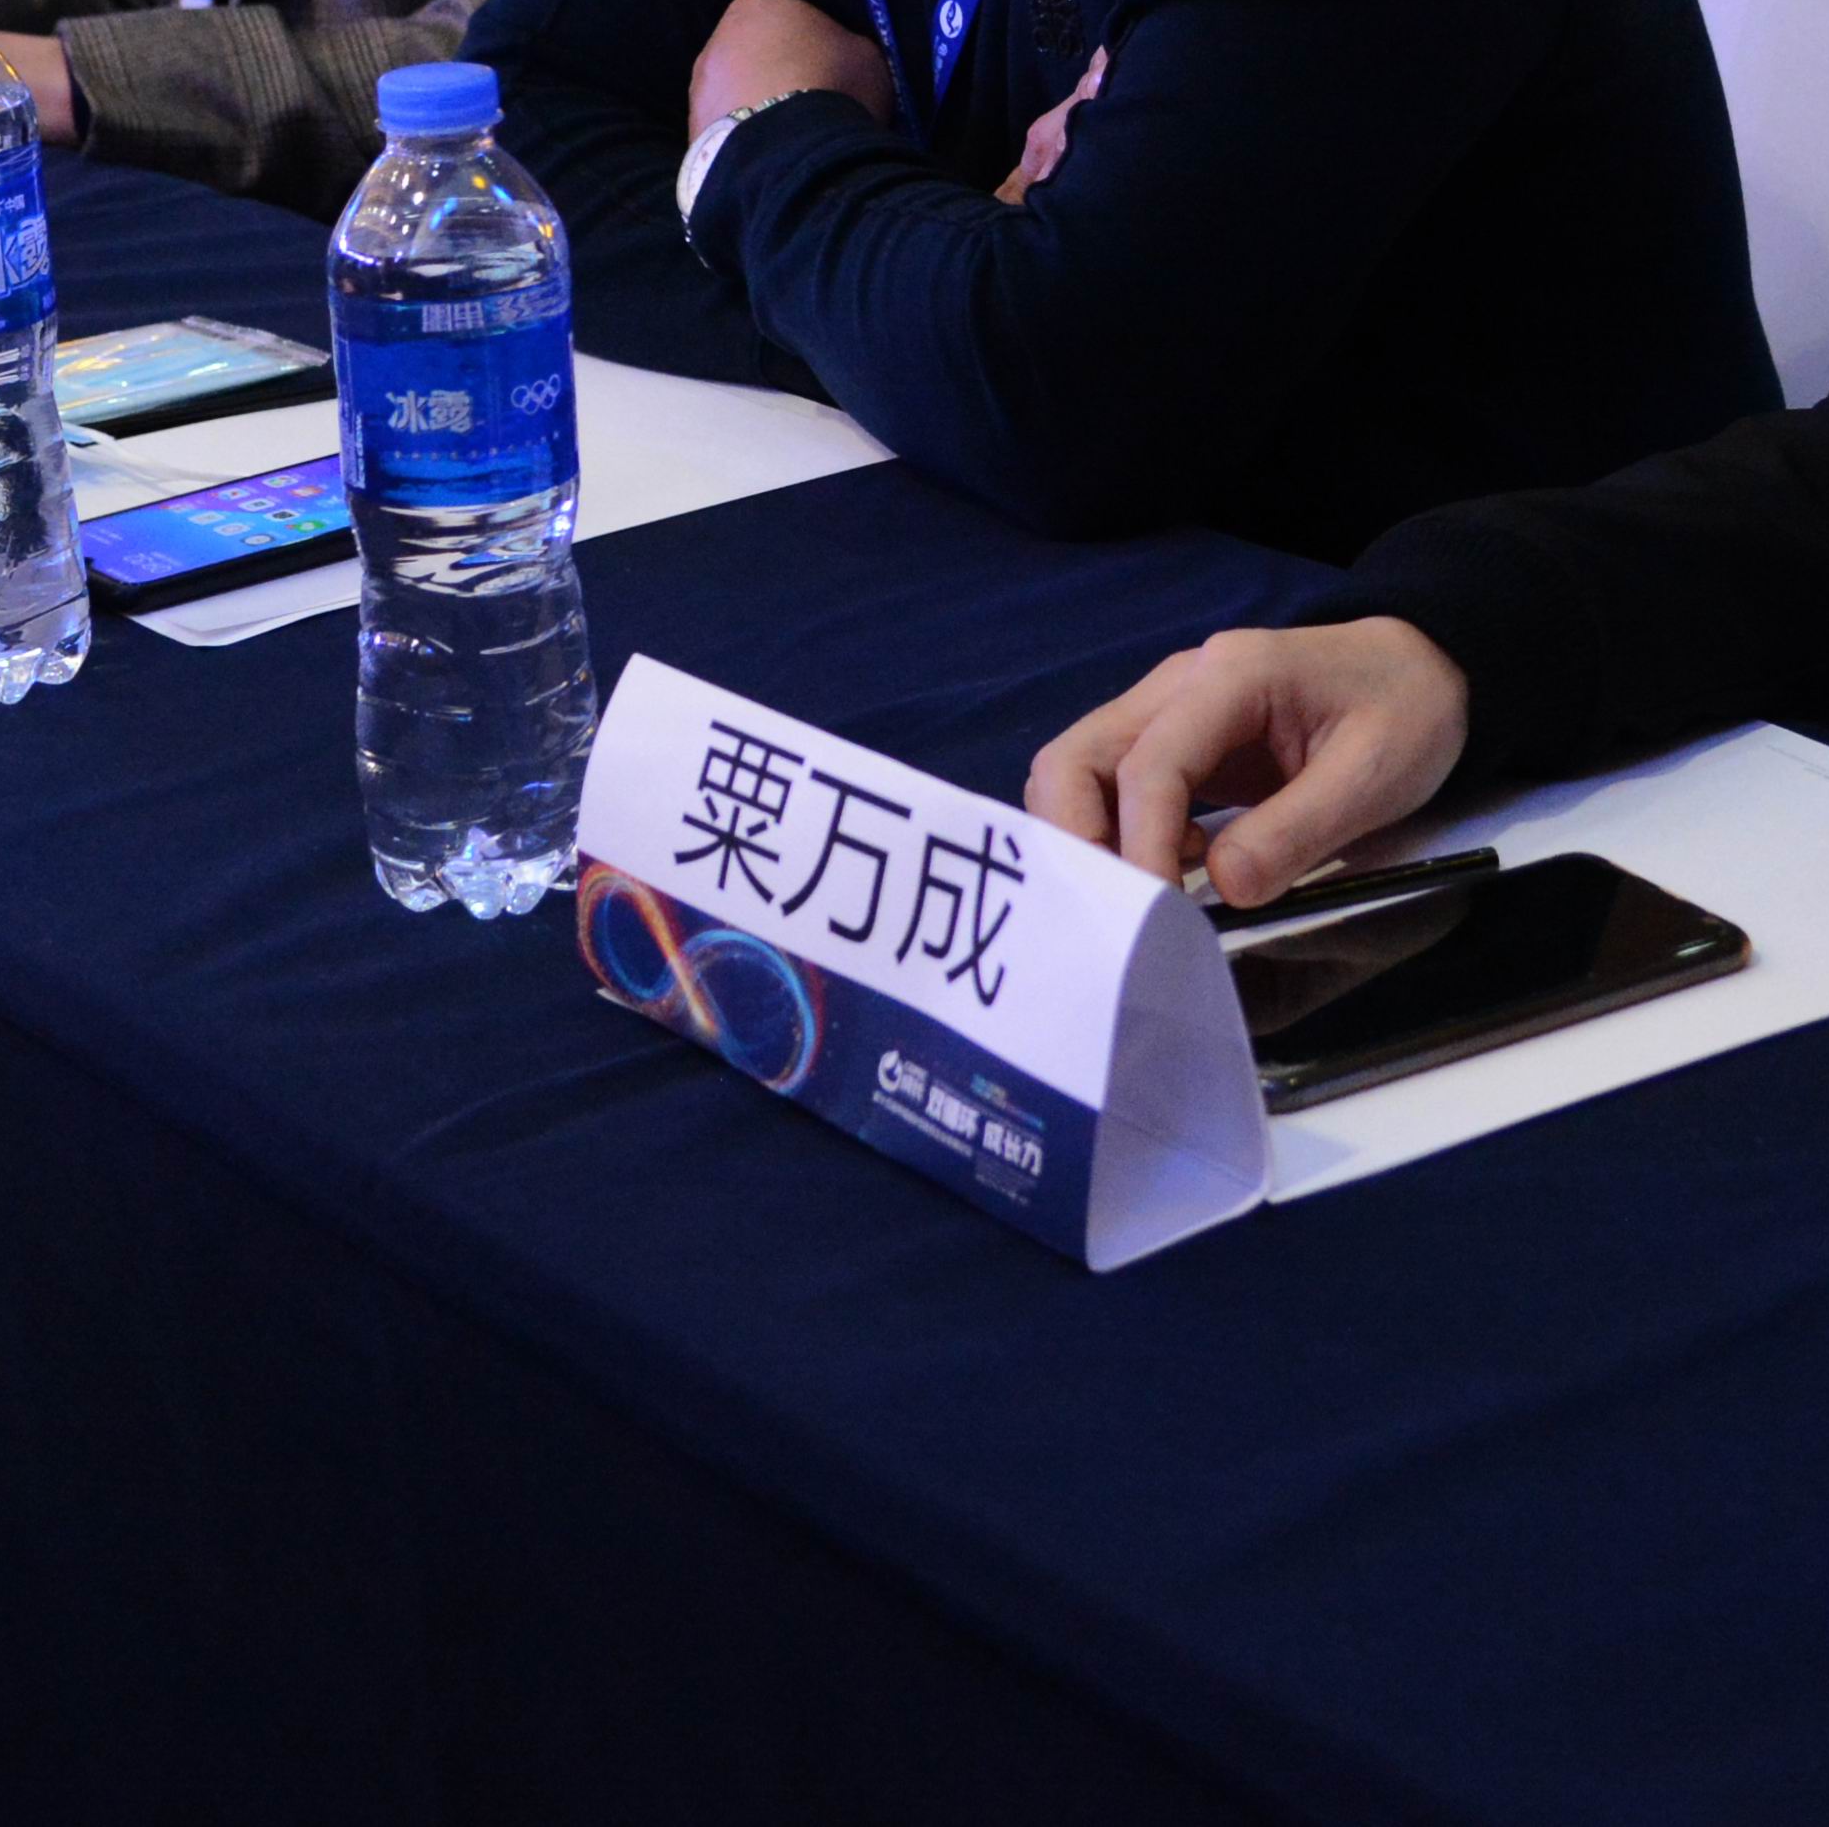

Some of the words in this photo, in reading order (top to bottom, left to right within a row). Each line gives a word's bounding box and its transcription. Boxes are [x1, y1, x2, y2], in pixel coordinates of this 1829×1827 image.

[385, 389, 474, 434] 冰露
[674, 719, 1025, 1007] 粟万成
